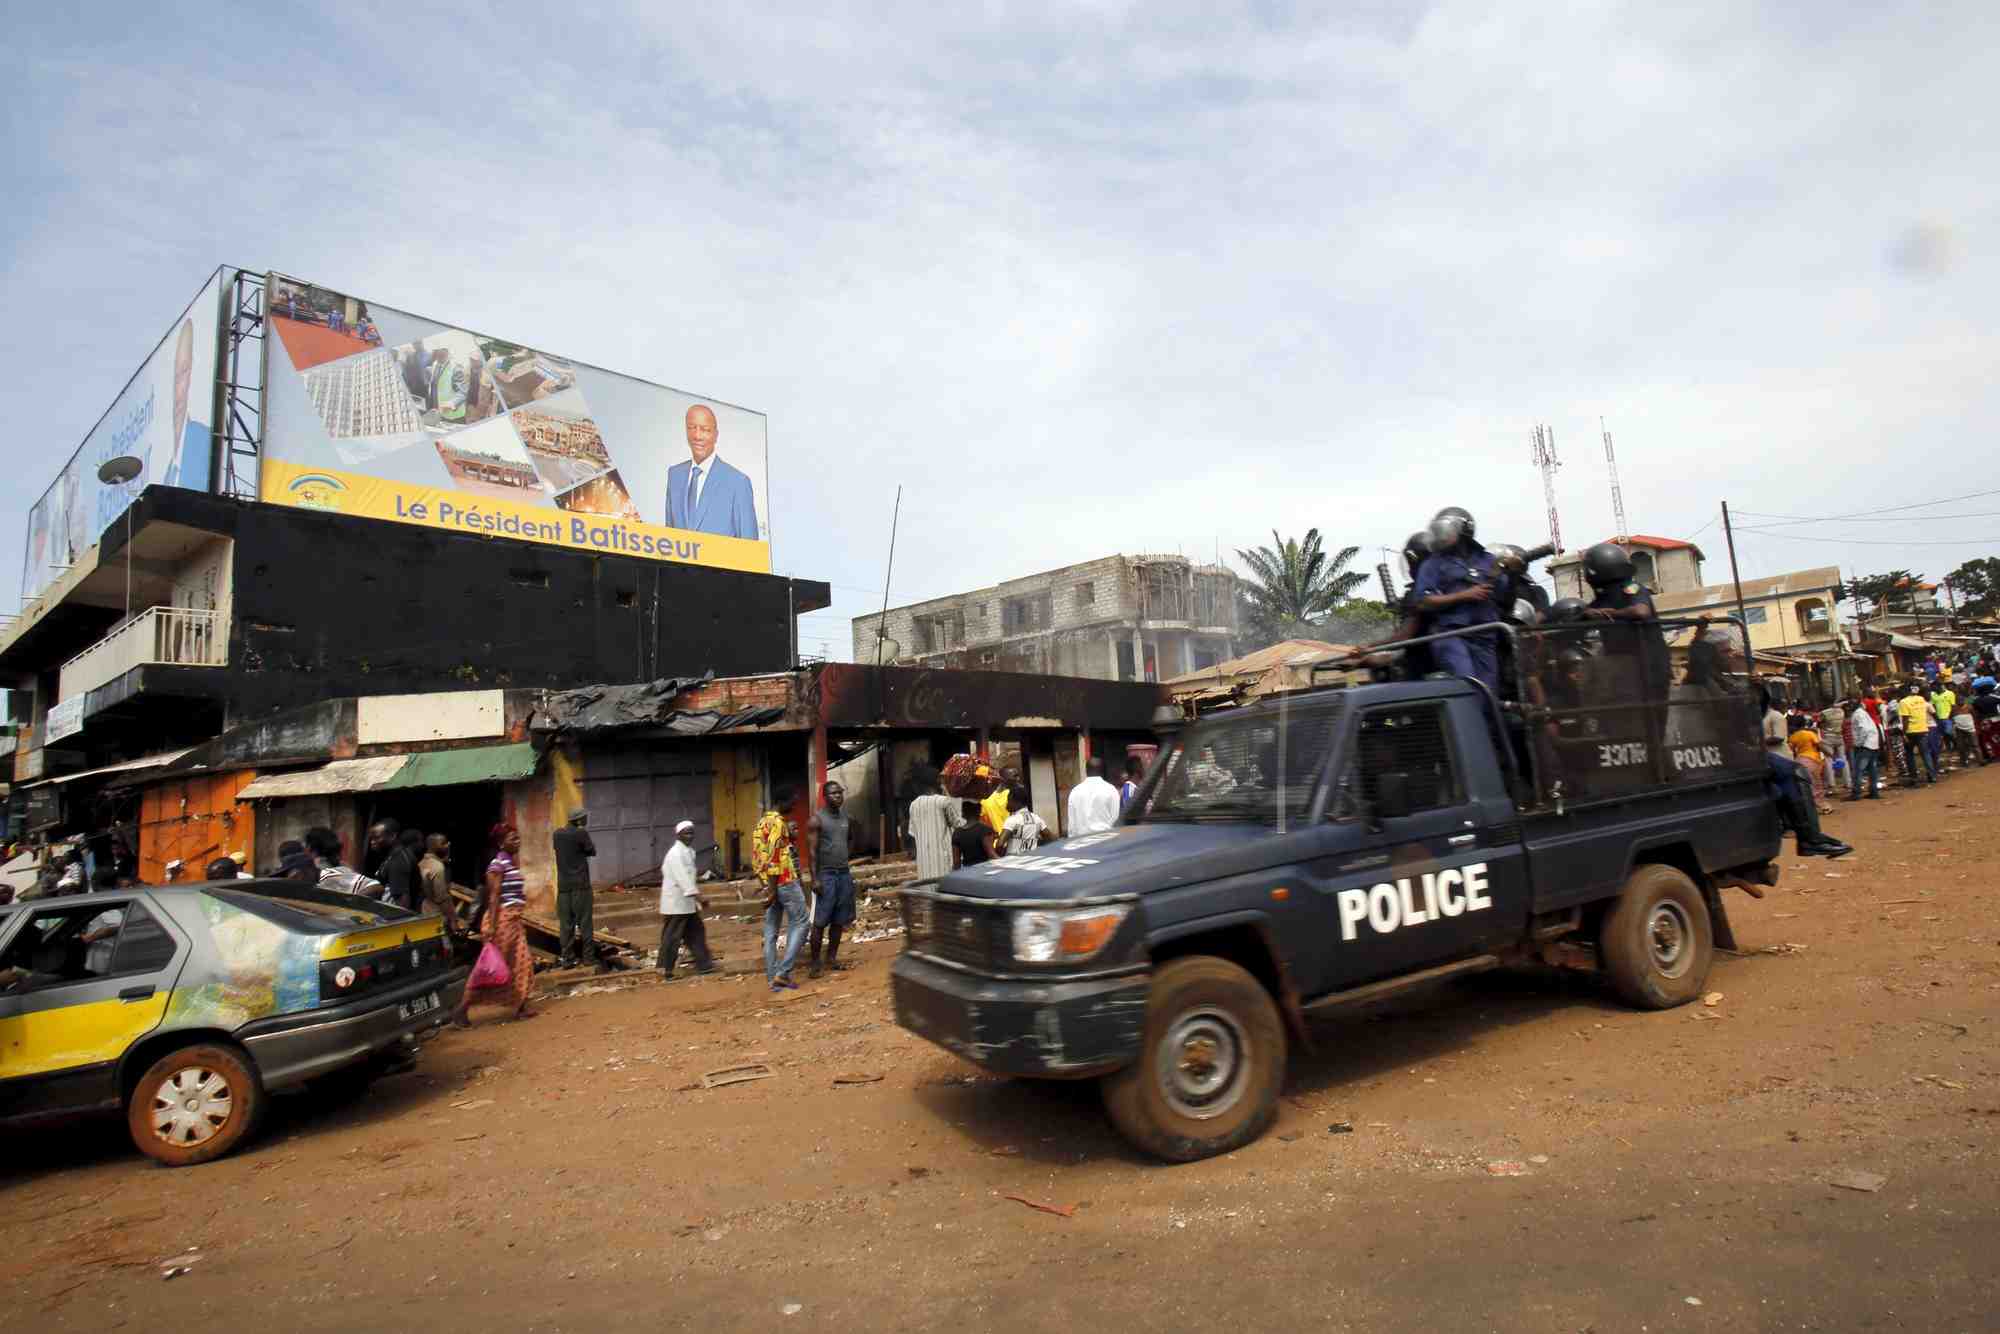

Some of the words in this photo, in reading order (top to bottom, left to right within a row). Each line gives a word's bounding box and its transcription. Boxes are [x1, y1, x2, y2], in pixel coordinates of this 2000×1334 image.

[396, 494, 429, 519] Le
[439, 502, 562, 541] Président
[571, 518, 702, 560] Batisseur
[1337, 862, 1492, 941] POLICE
